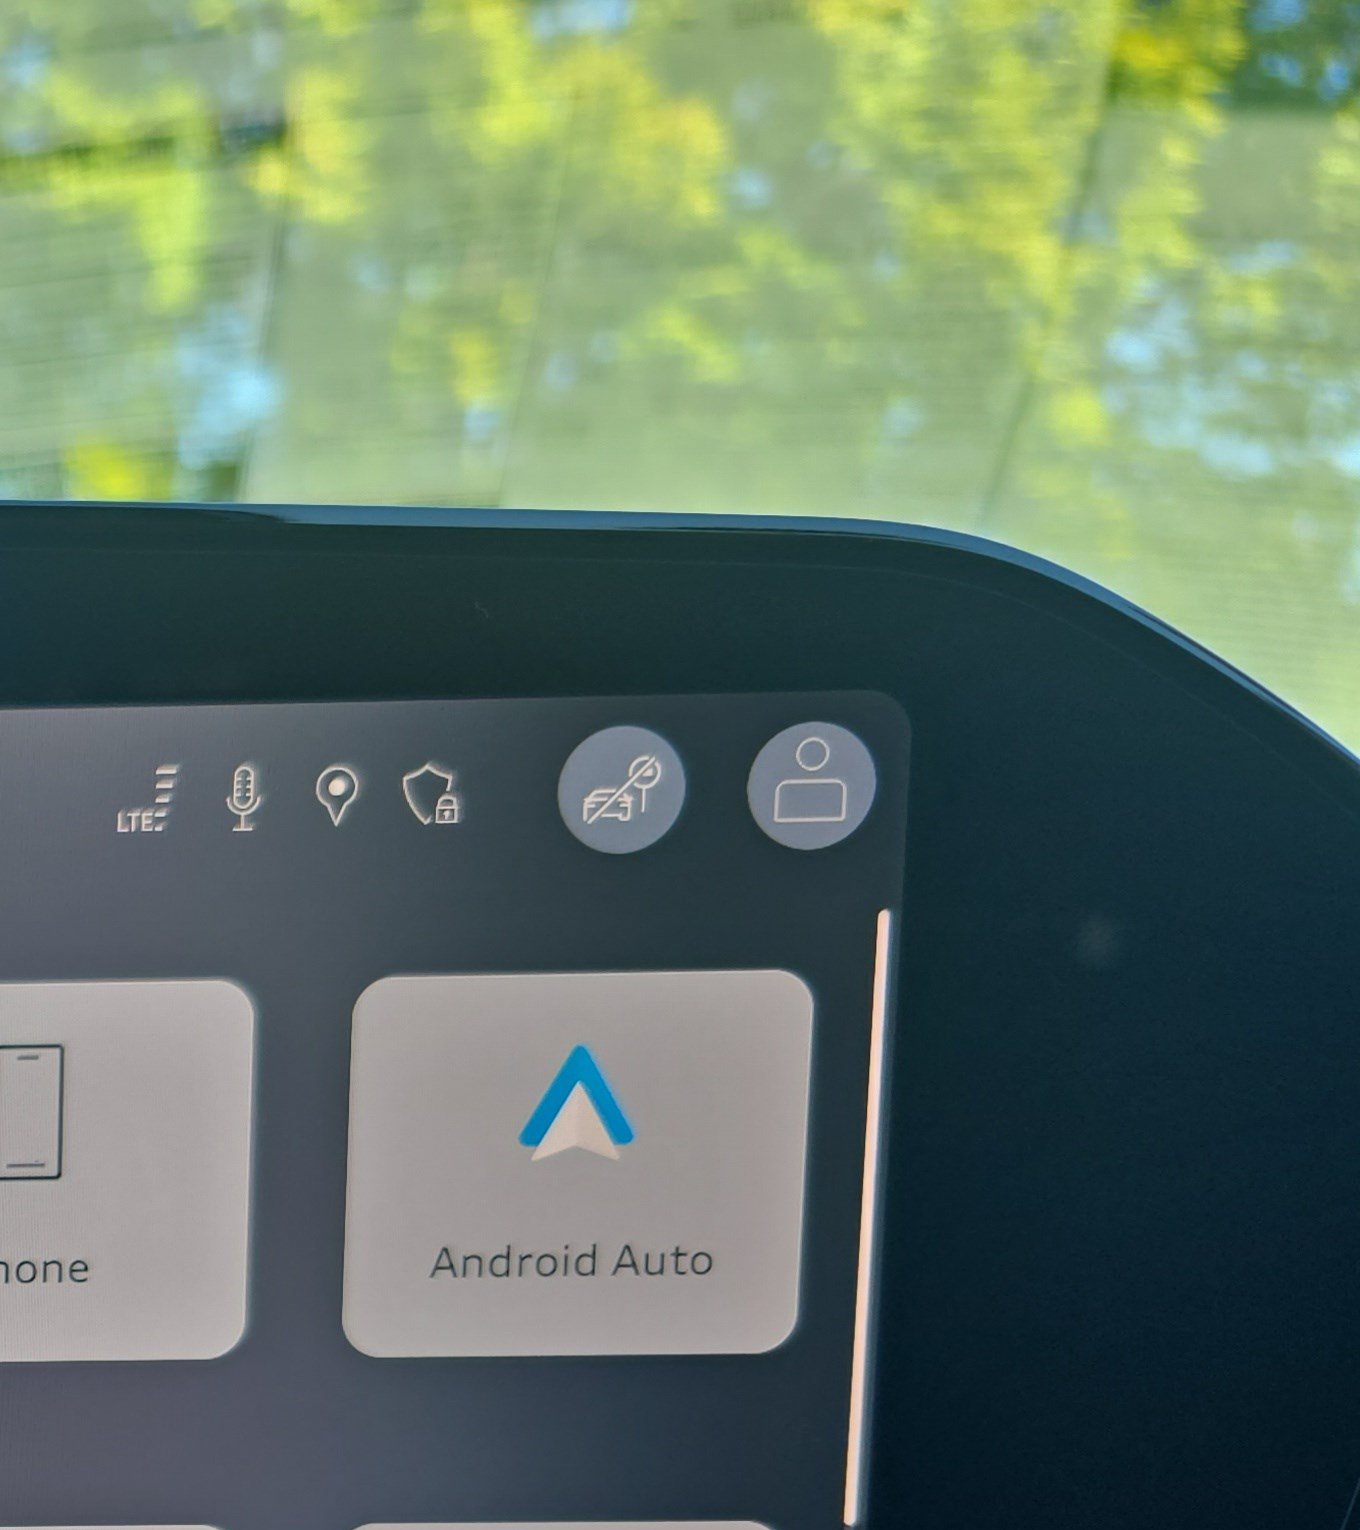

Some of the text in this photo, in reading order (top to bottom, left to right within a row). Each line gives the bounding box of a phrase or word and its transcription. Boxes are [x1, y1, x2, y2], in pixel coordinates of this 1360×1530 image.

[117, 809, 155, 832] LTE
[430, 1243, 713, 1278] Android Auto
